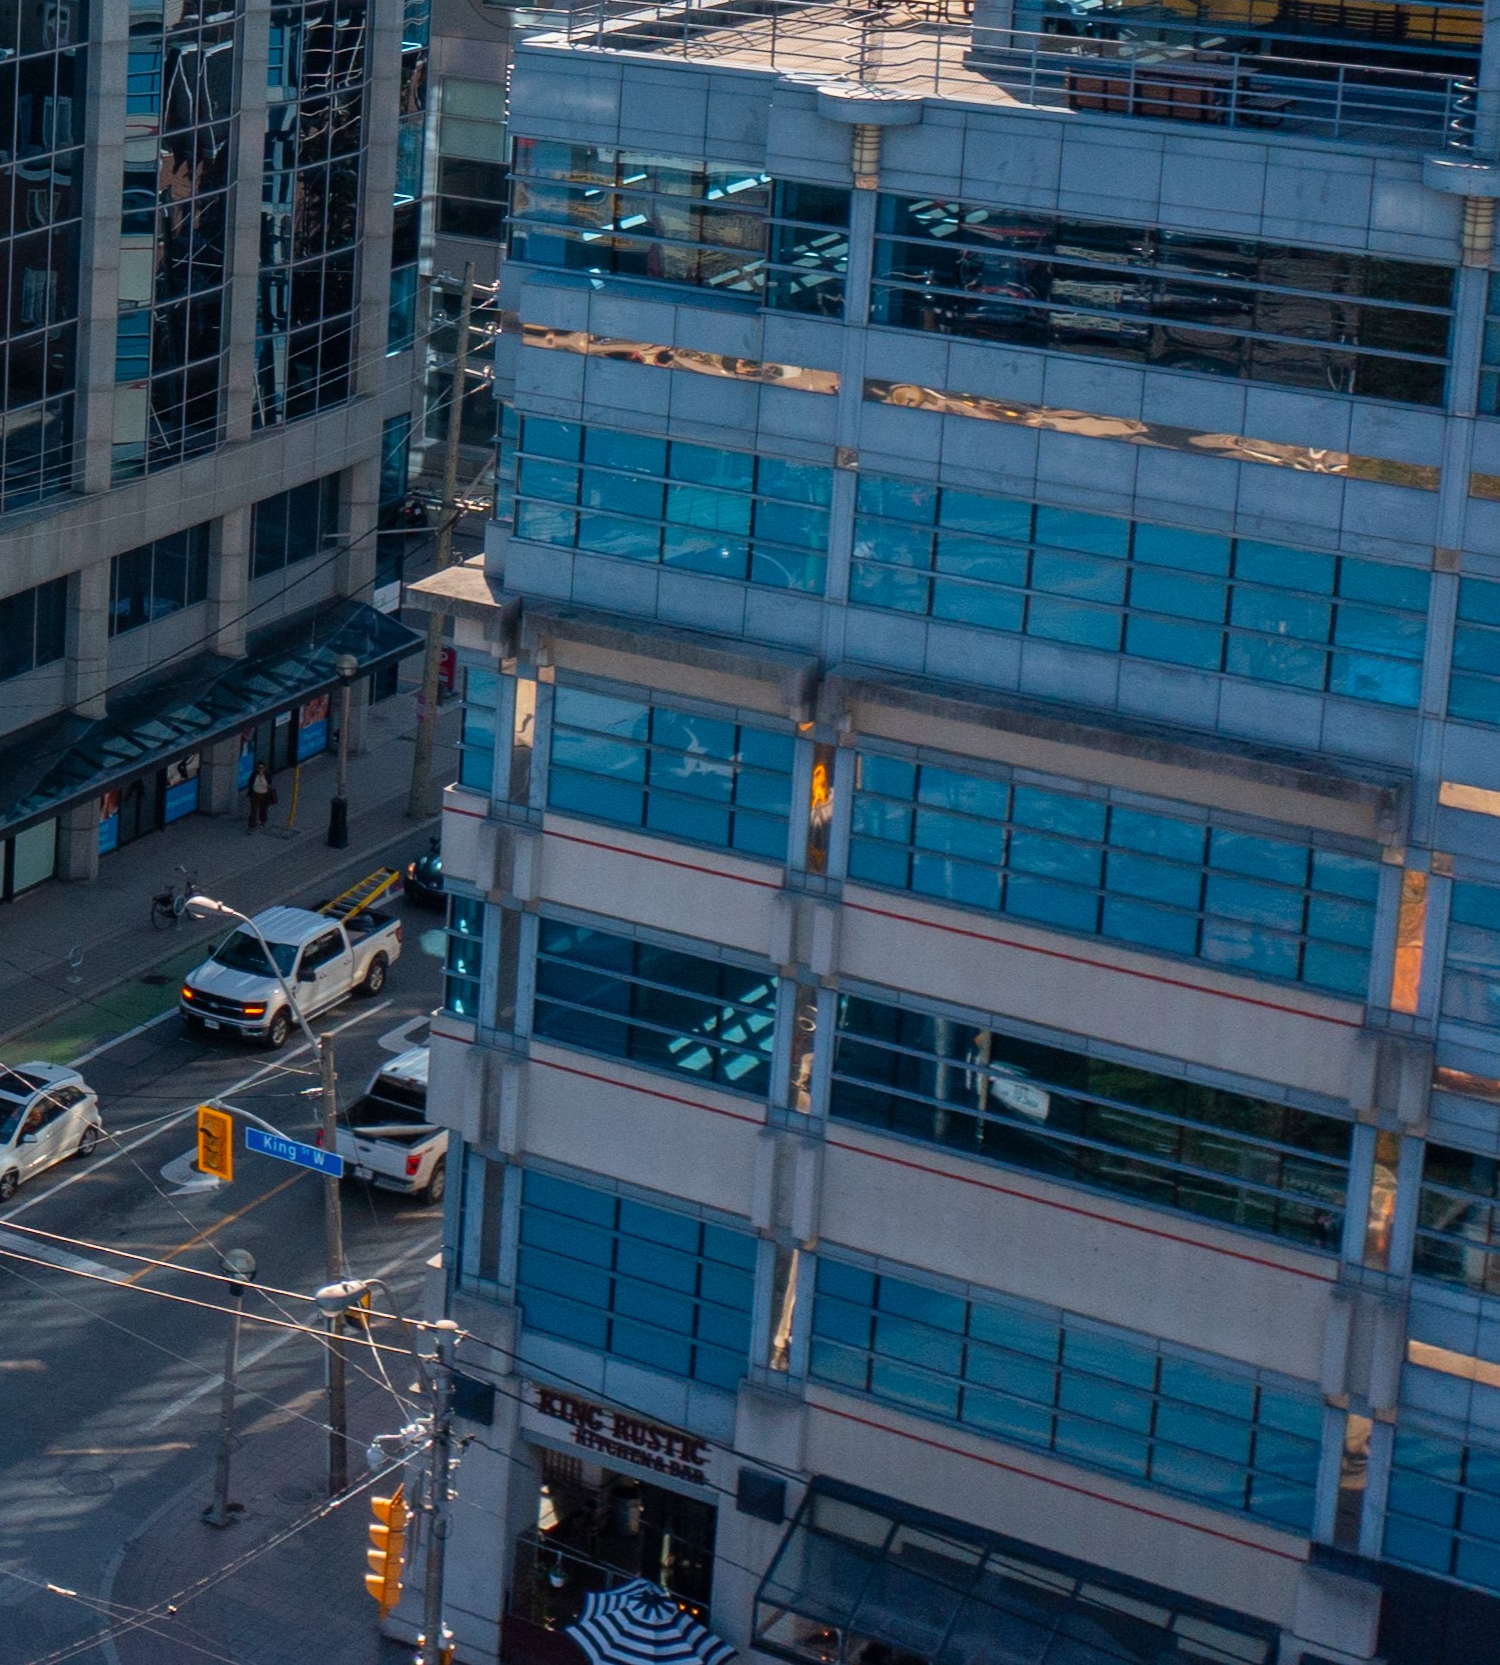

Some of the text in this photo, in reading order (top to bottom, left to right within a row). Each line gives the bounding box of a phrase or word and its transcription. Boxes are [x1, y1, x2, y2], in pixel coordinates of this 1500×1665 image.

[263, 1135, 297, 1161] King
[313, 1150, 326, 1166] W
[536, 1387, 711, 1466] KING RUSTIC
